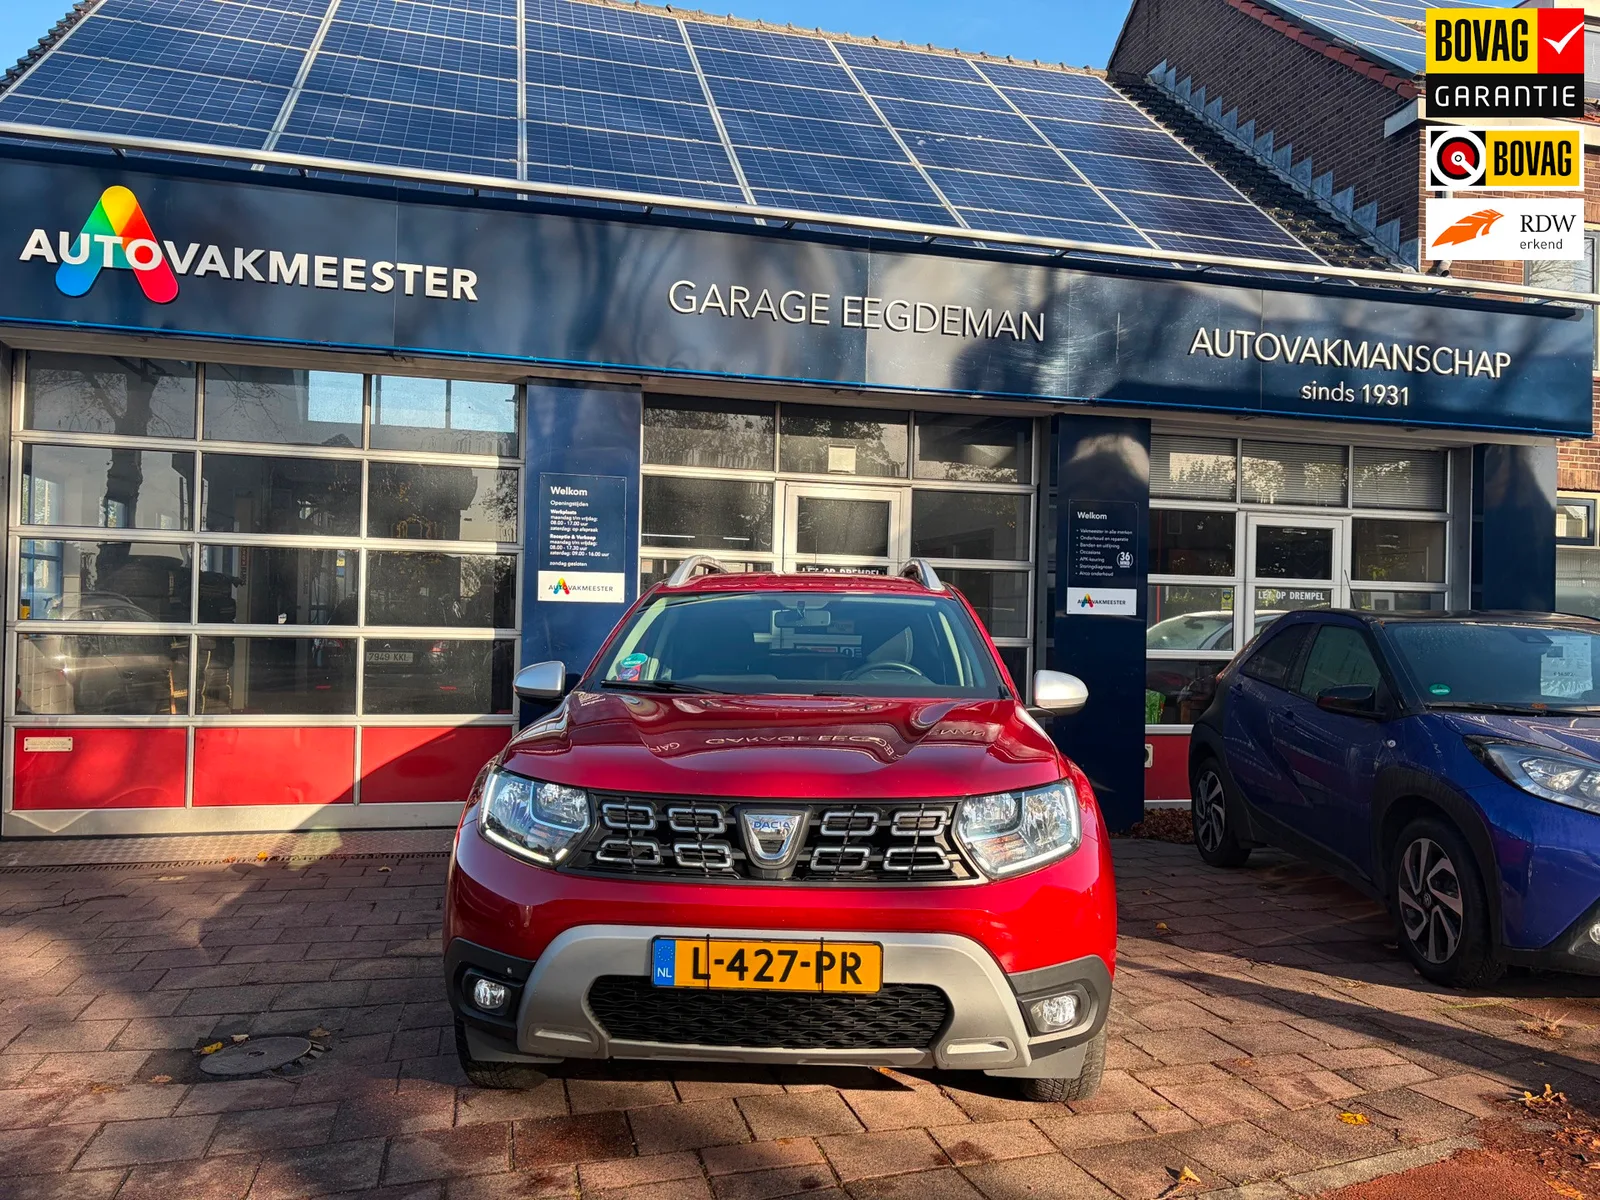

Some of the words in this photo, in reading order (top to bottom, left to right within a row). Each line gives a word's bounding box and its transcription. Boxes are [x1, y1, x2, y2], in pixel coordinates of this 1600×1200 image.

[19, 228, 478, 301] AUTOVAKMEESTER
[668, 280, 831, 326] GARAGE
[842, 295, 1045, 342] EEGDEMAN
[1189, 326, 1512, 379] AUTOVAKMANSCHAP
[1301, 380, 1355, 403] sinds
[1362, 383, 1410, 406] 1931
[550, 486, 588, 496] Welkom
[1077, 511, 1108, 520] Welkom
[1120, 552, 1130, 560] 36
[1258, 590, 1272, 599] LET
[1276, 591, 1286, 599] OP
[1290, 592, 1324, 600] DREMPEL
[657, 967, 672, 978] NL
[692, 946, 862, 985] L-427-PR
